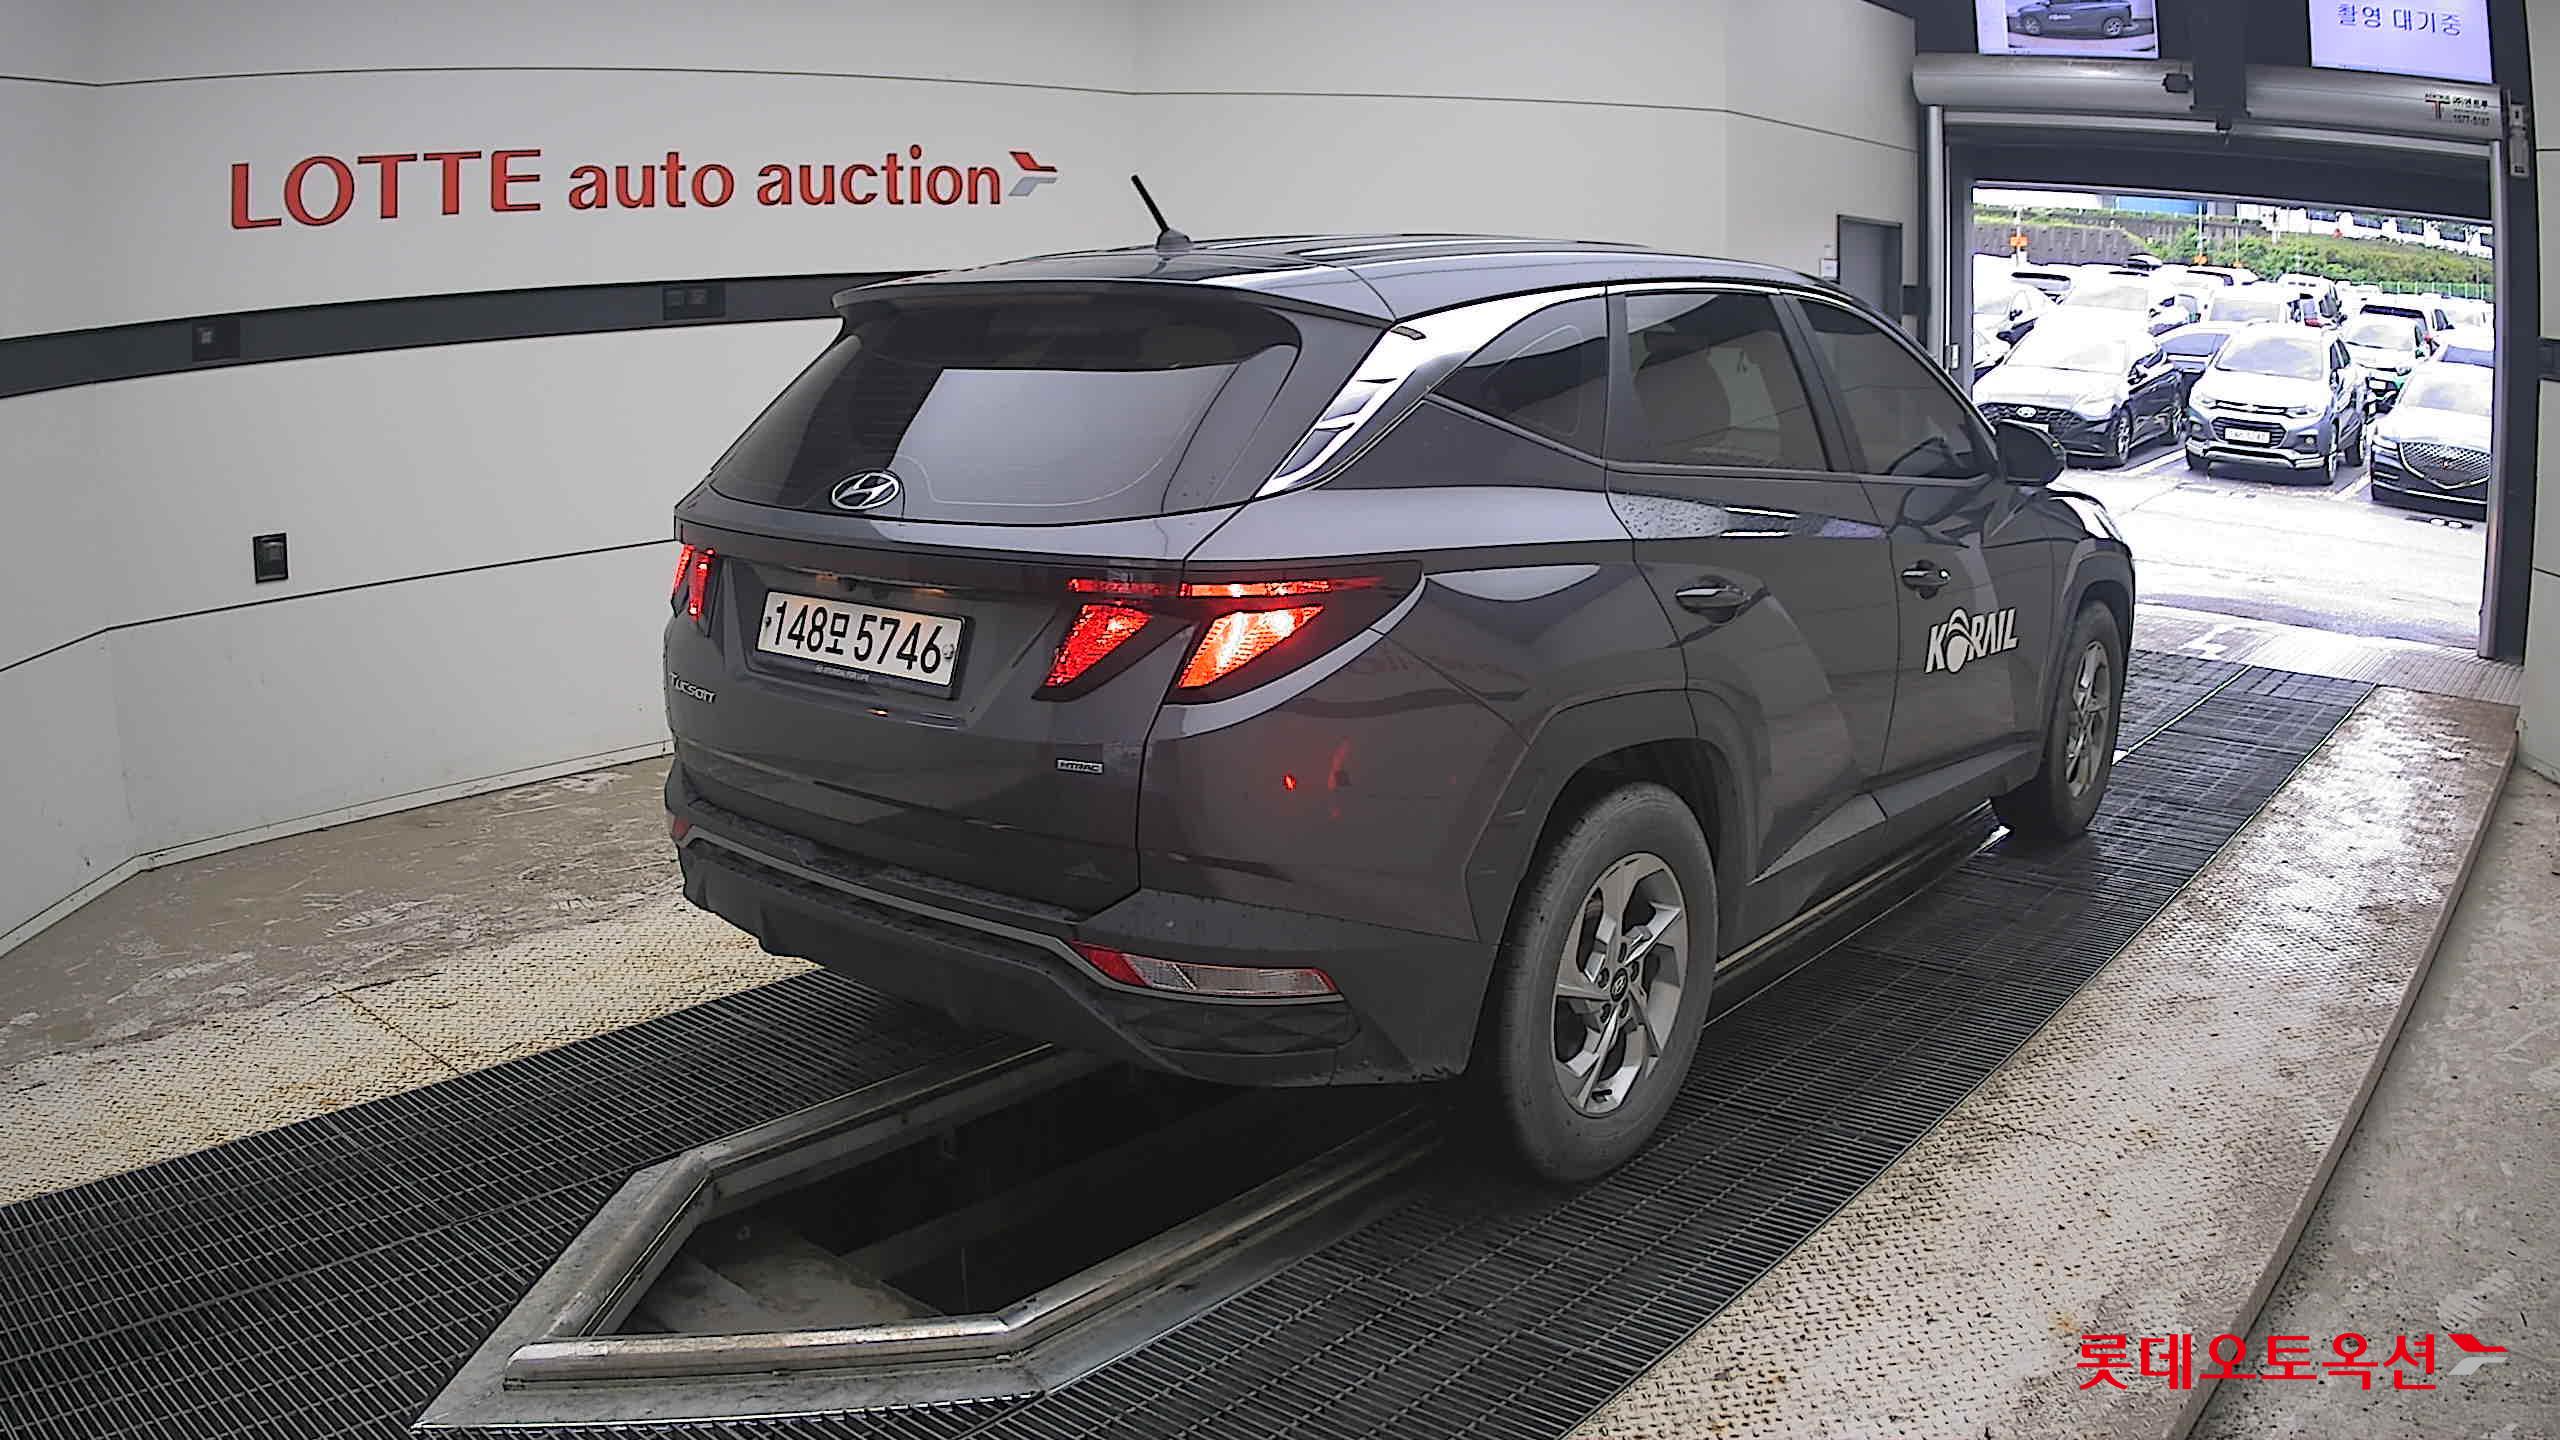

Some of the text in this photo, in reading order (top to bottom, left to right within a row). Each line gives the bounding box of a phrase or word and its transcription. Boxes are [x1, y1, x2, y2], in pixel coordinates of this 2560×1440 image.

[2337, 4, 2461, 36] 촬영 대기중
[231, 144, 1001, 230] LOTTE auto auction
[1924, 606, 2019, 673] KORAIL
